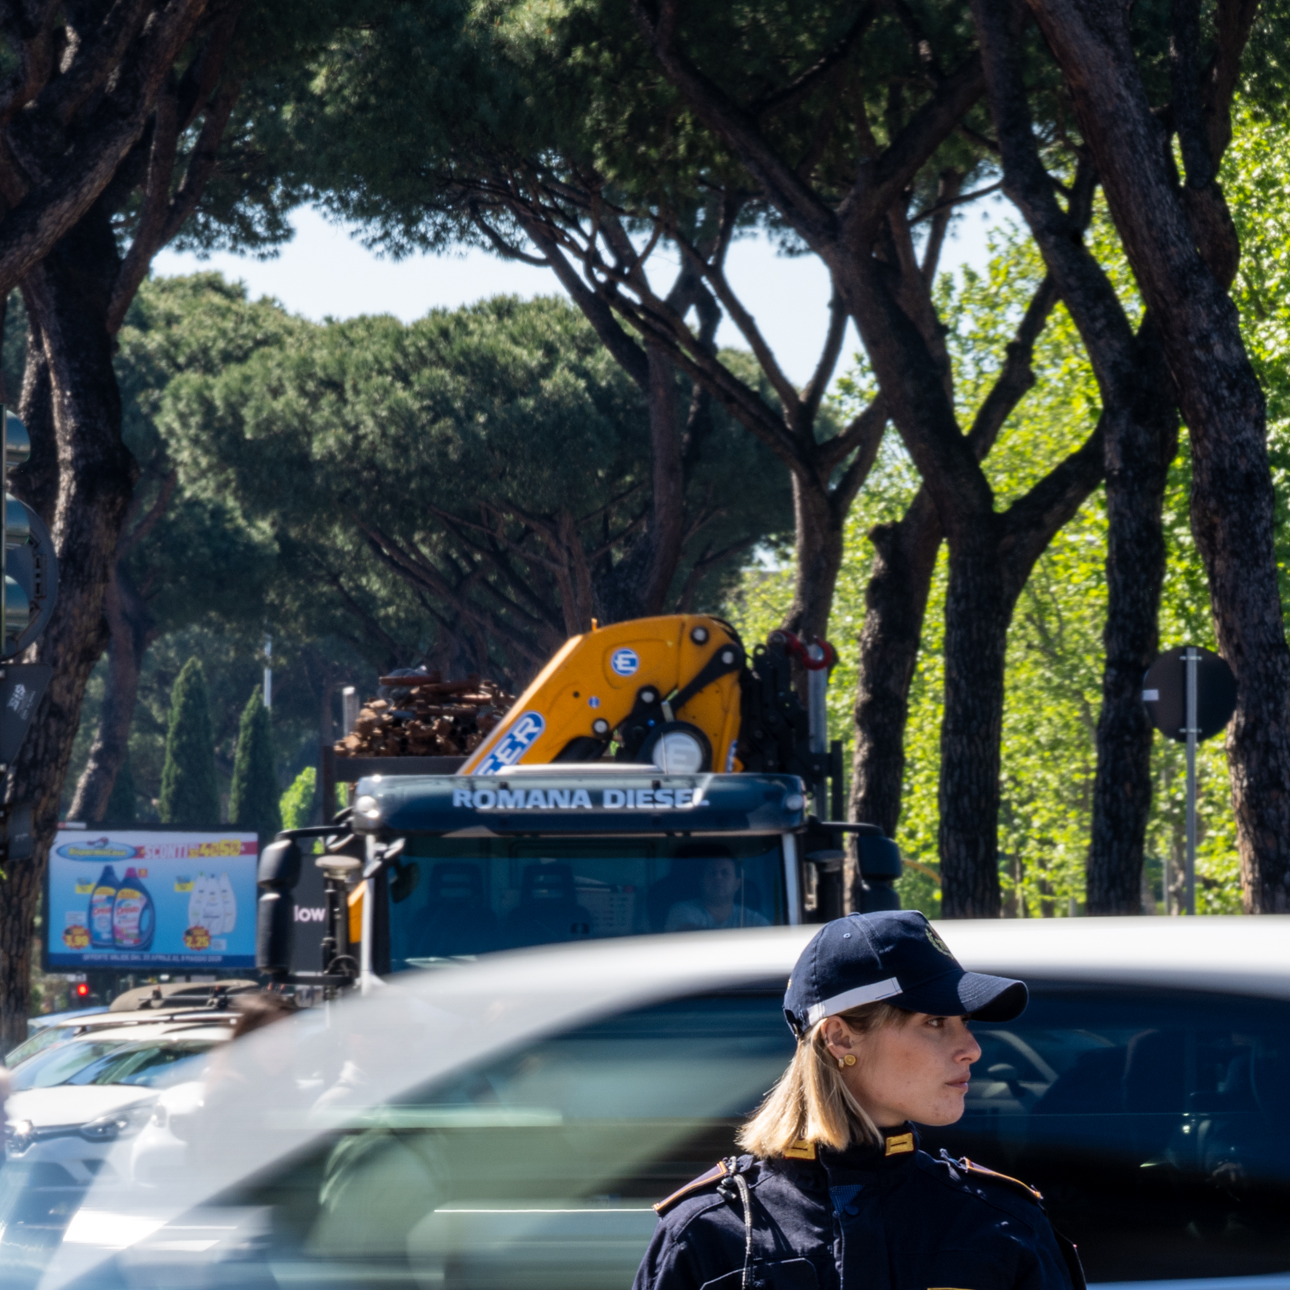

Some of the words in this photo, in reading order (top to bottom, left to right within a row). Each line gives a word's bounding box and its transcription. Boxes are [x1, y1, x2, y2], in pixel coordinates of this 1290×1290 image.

[452, 788, 593, 810] ROMANA
[602, 788, 710, 809] DIESEL
[144, 843, 188, 859] SCONTI
